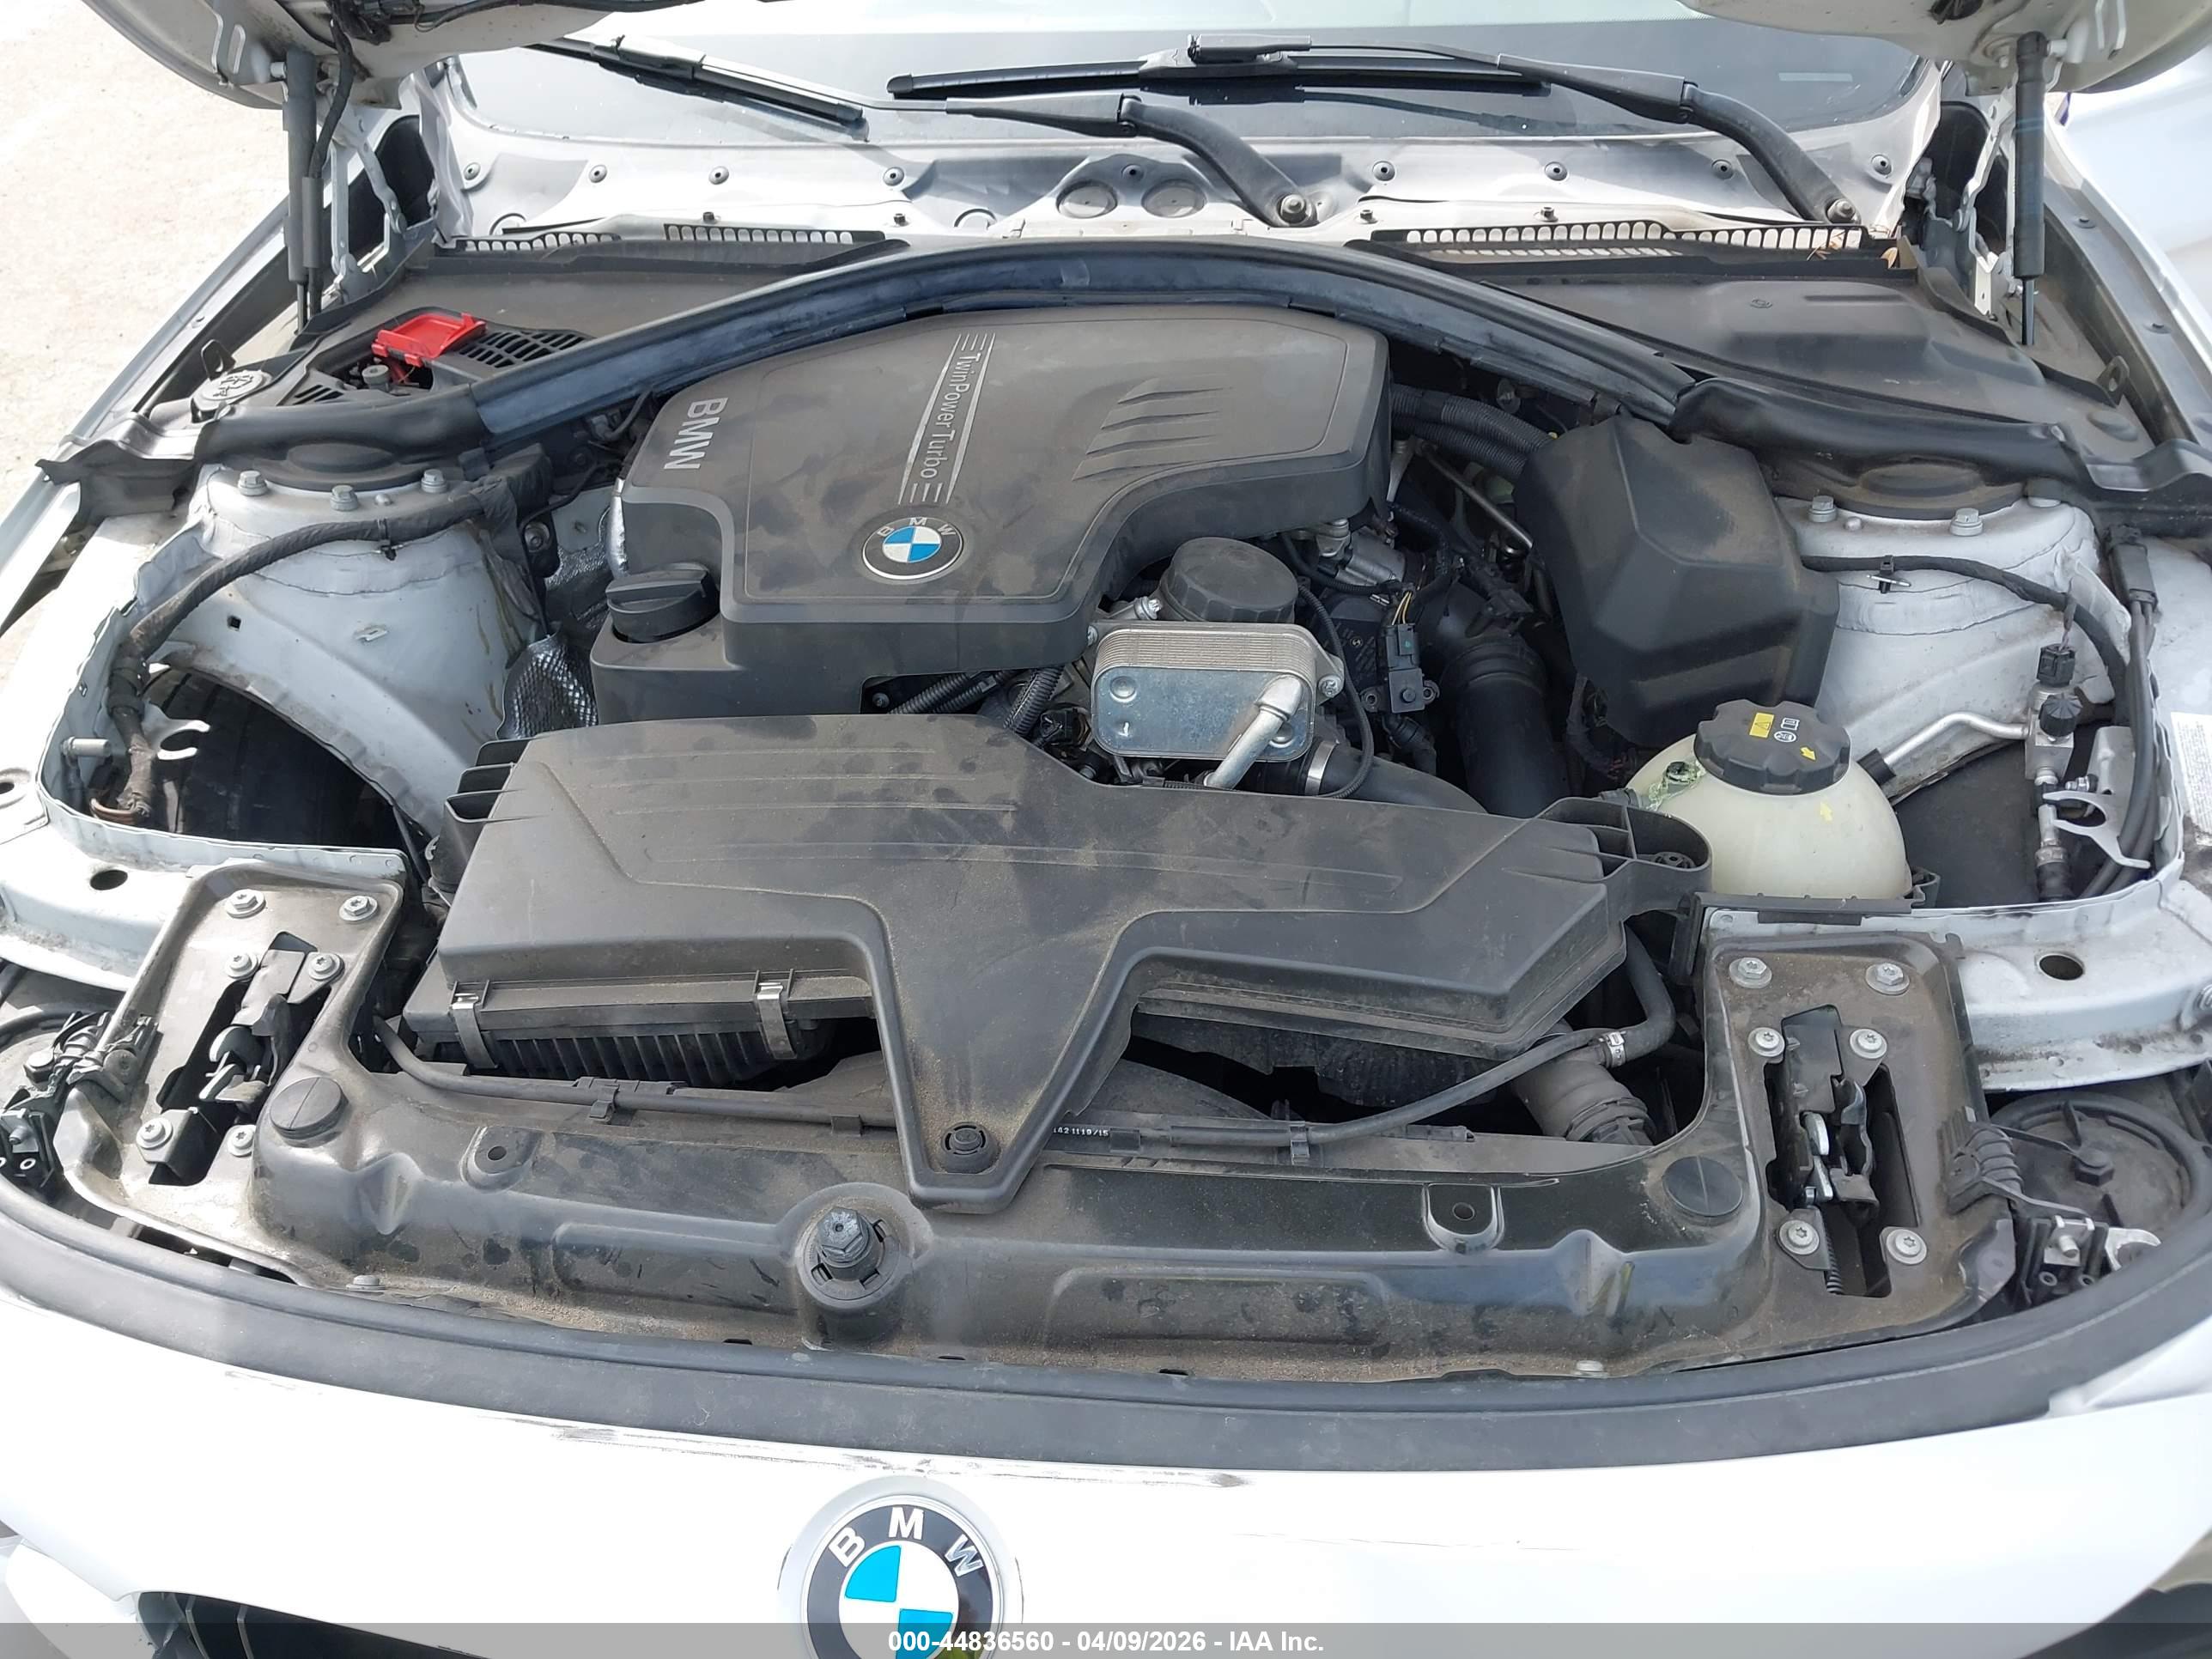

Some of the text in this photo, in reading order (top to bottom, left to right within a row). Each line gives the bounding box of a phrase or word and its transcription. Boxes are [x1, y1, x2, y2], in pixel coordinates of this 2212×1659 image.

[664, 397, 729, 470] BMW
[920, 352, 981, 478] TwinPower Turbo
[877, 517, 957, 538] BMW
[827, 1505, 985, 1578] BMW
